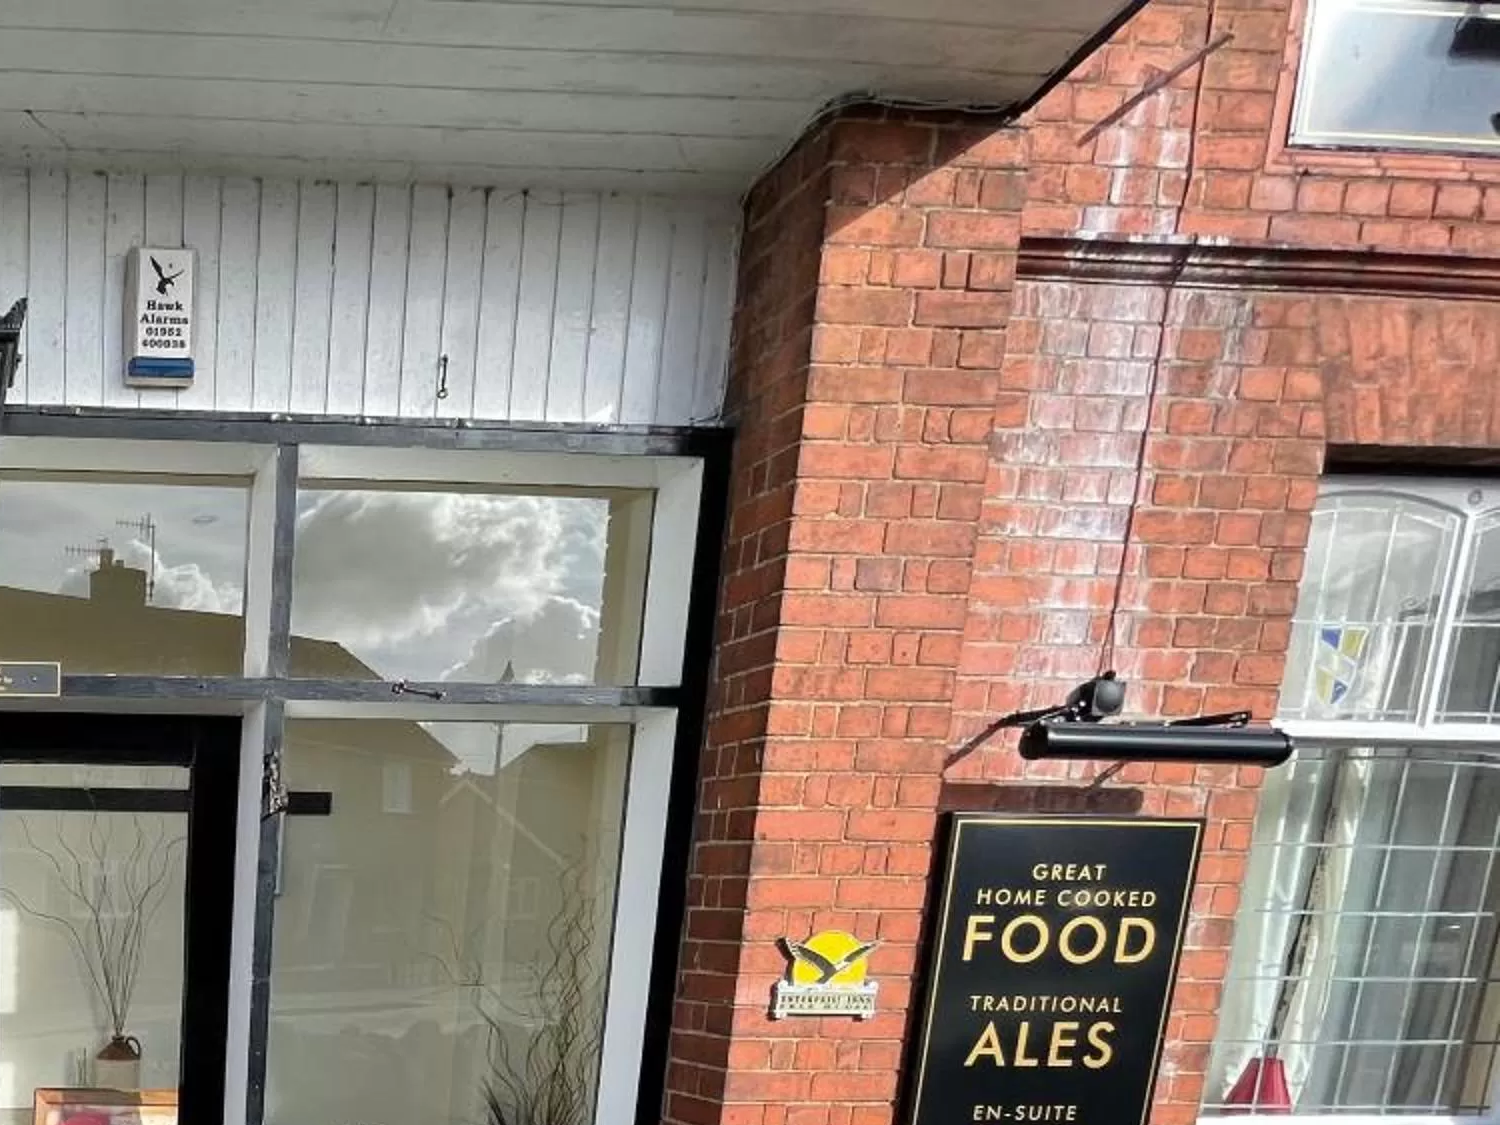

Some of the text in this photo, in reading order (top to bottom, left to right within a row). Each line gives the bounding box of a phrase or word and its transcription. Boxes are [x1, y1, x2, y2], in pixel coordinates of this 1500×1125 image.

[147, 300, 183, 311] Hawk
[140, 313, 188, 324] Alarms
[1032, 864, 1107, 881] GREAT
[977, 889, 1157, 907] HOME COOKED
[962, 914, 1157, 965] FOOD
[969, 995, 1124, 1013] TRADITIONAL
[964, 1021, 1117, 1069] ALES
[973, 1105, 1078, 1122] EN-SUITE
